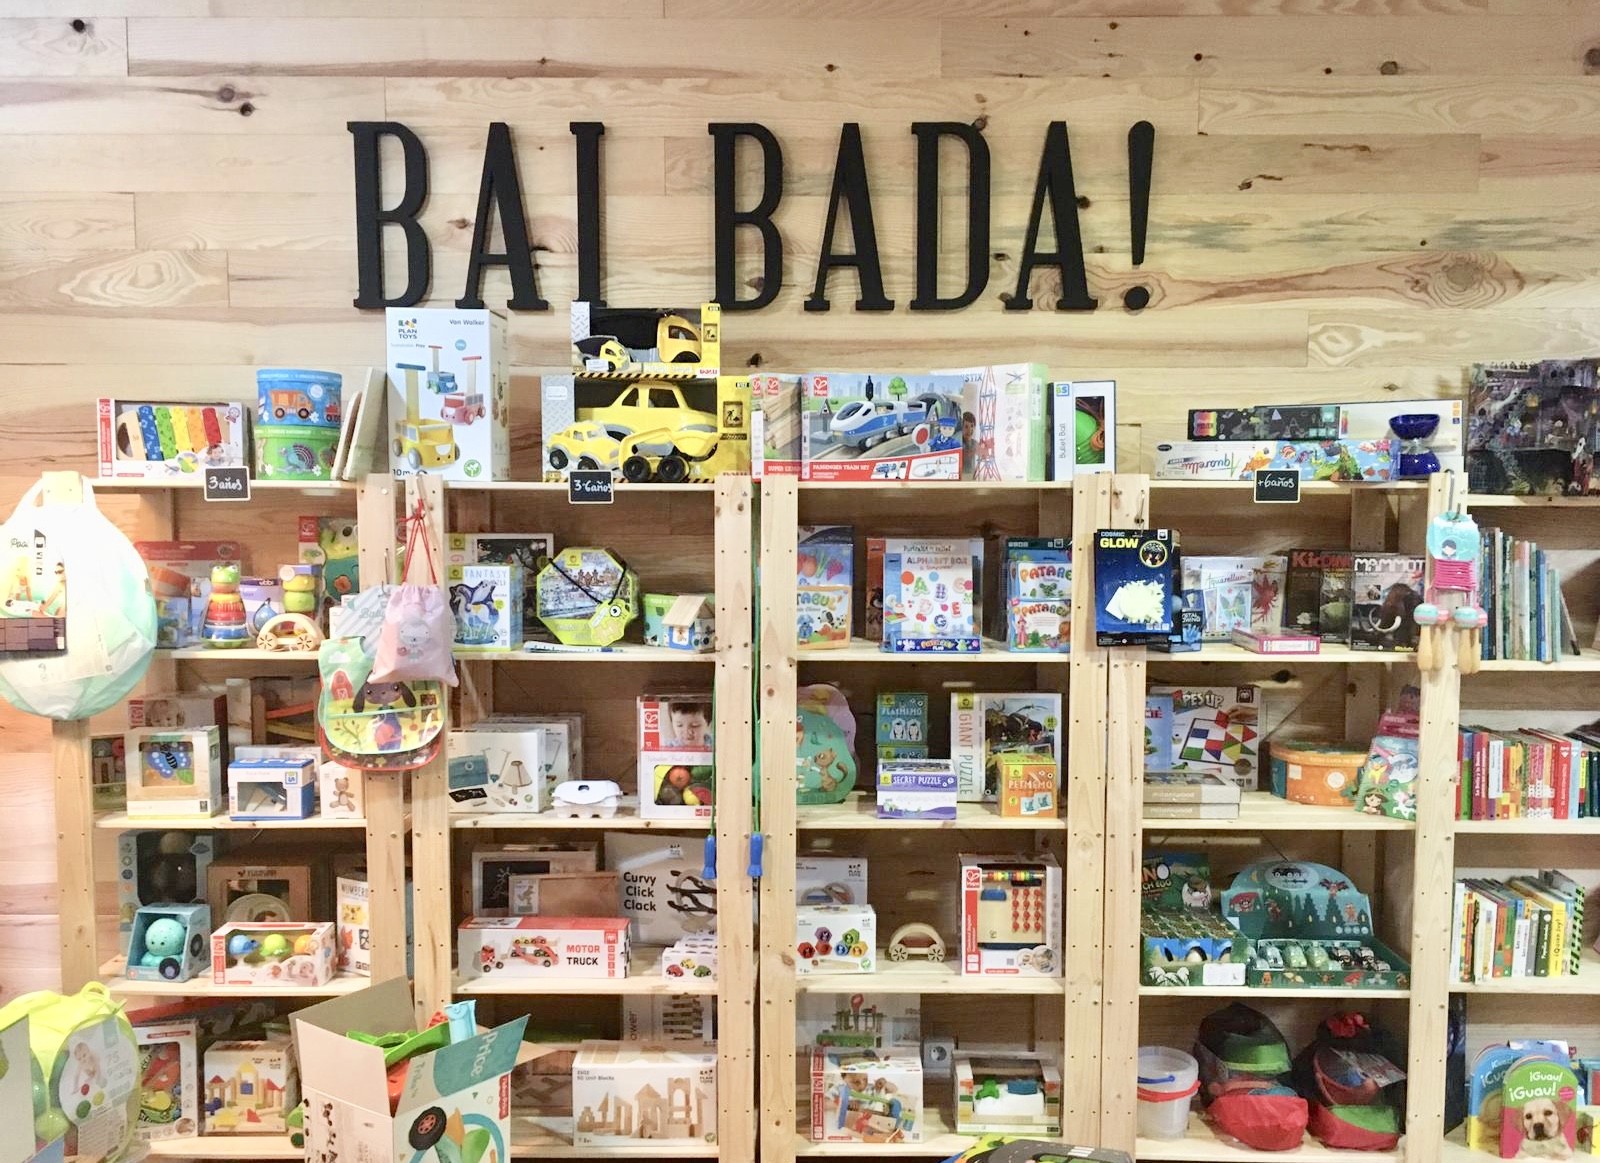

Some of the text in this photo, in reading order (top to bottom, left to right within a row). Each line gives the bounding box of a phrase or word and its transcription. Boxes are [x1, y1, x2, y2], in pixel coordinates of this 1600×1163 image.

[347, 120, 1156, 312] BAI BADA!
[1099, 538, 1139, 549] GLOW
[1354, 556, 1426, 572] MAMMOT
[958, 713, 974, 796] GIANT PUZZLE
[893, 775, 942, 785] SECRET PUZZLE
[623, 871, 657, 886] Curvy
[625, 885, 655, 898] Click
[623, 899, 657, 912] Clack
[566, 944, 600, 954] MOTOR
[566, 957, 599, 966] TRUCK
